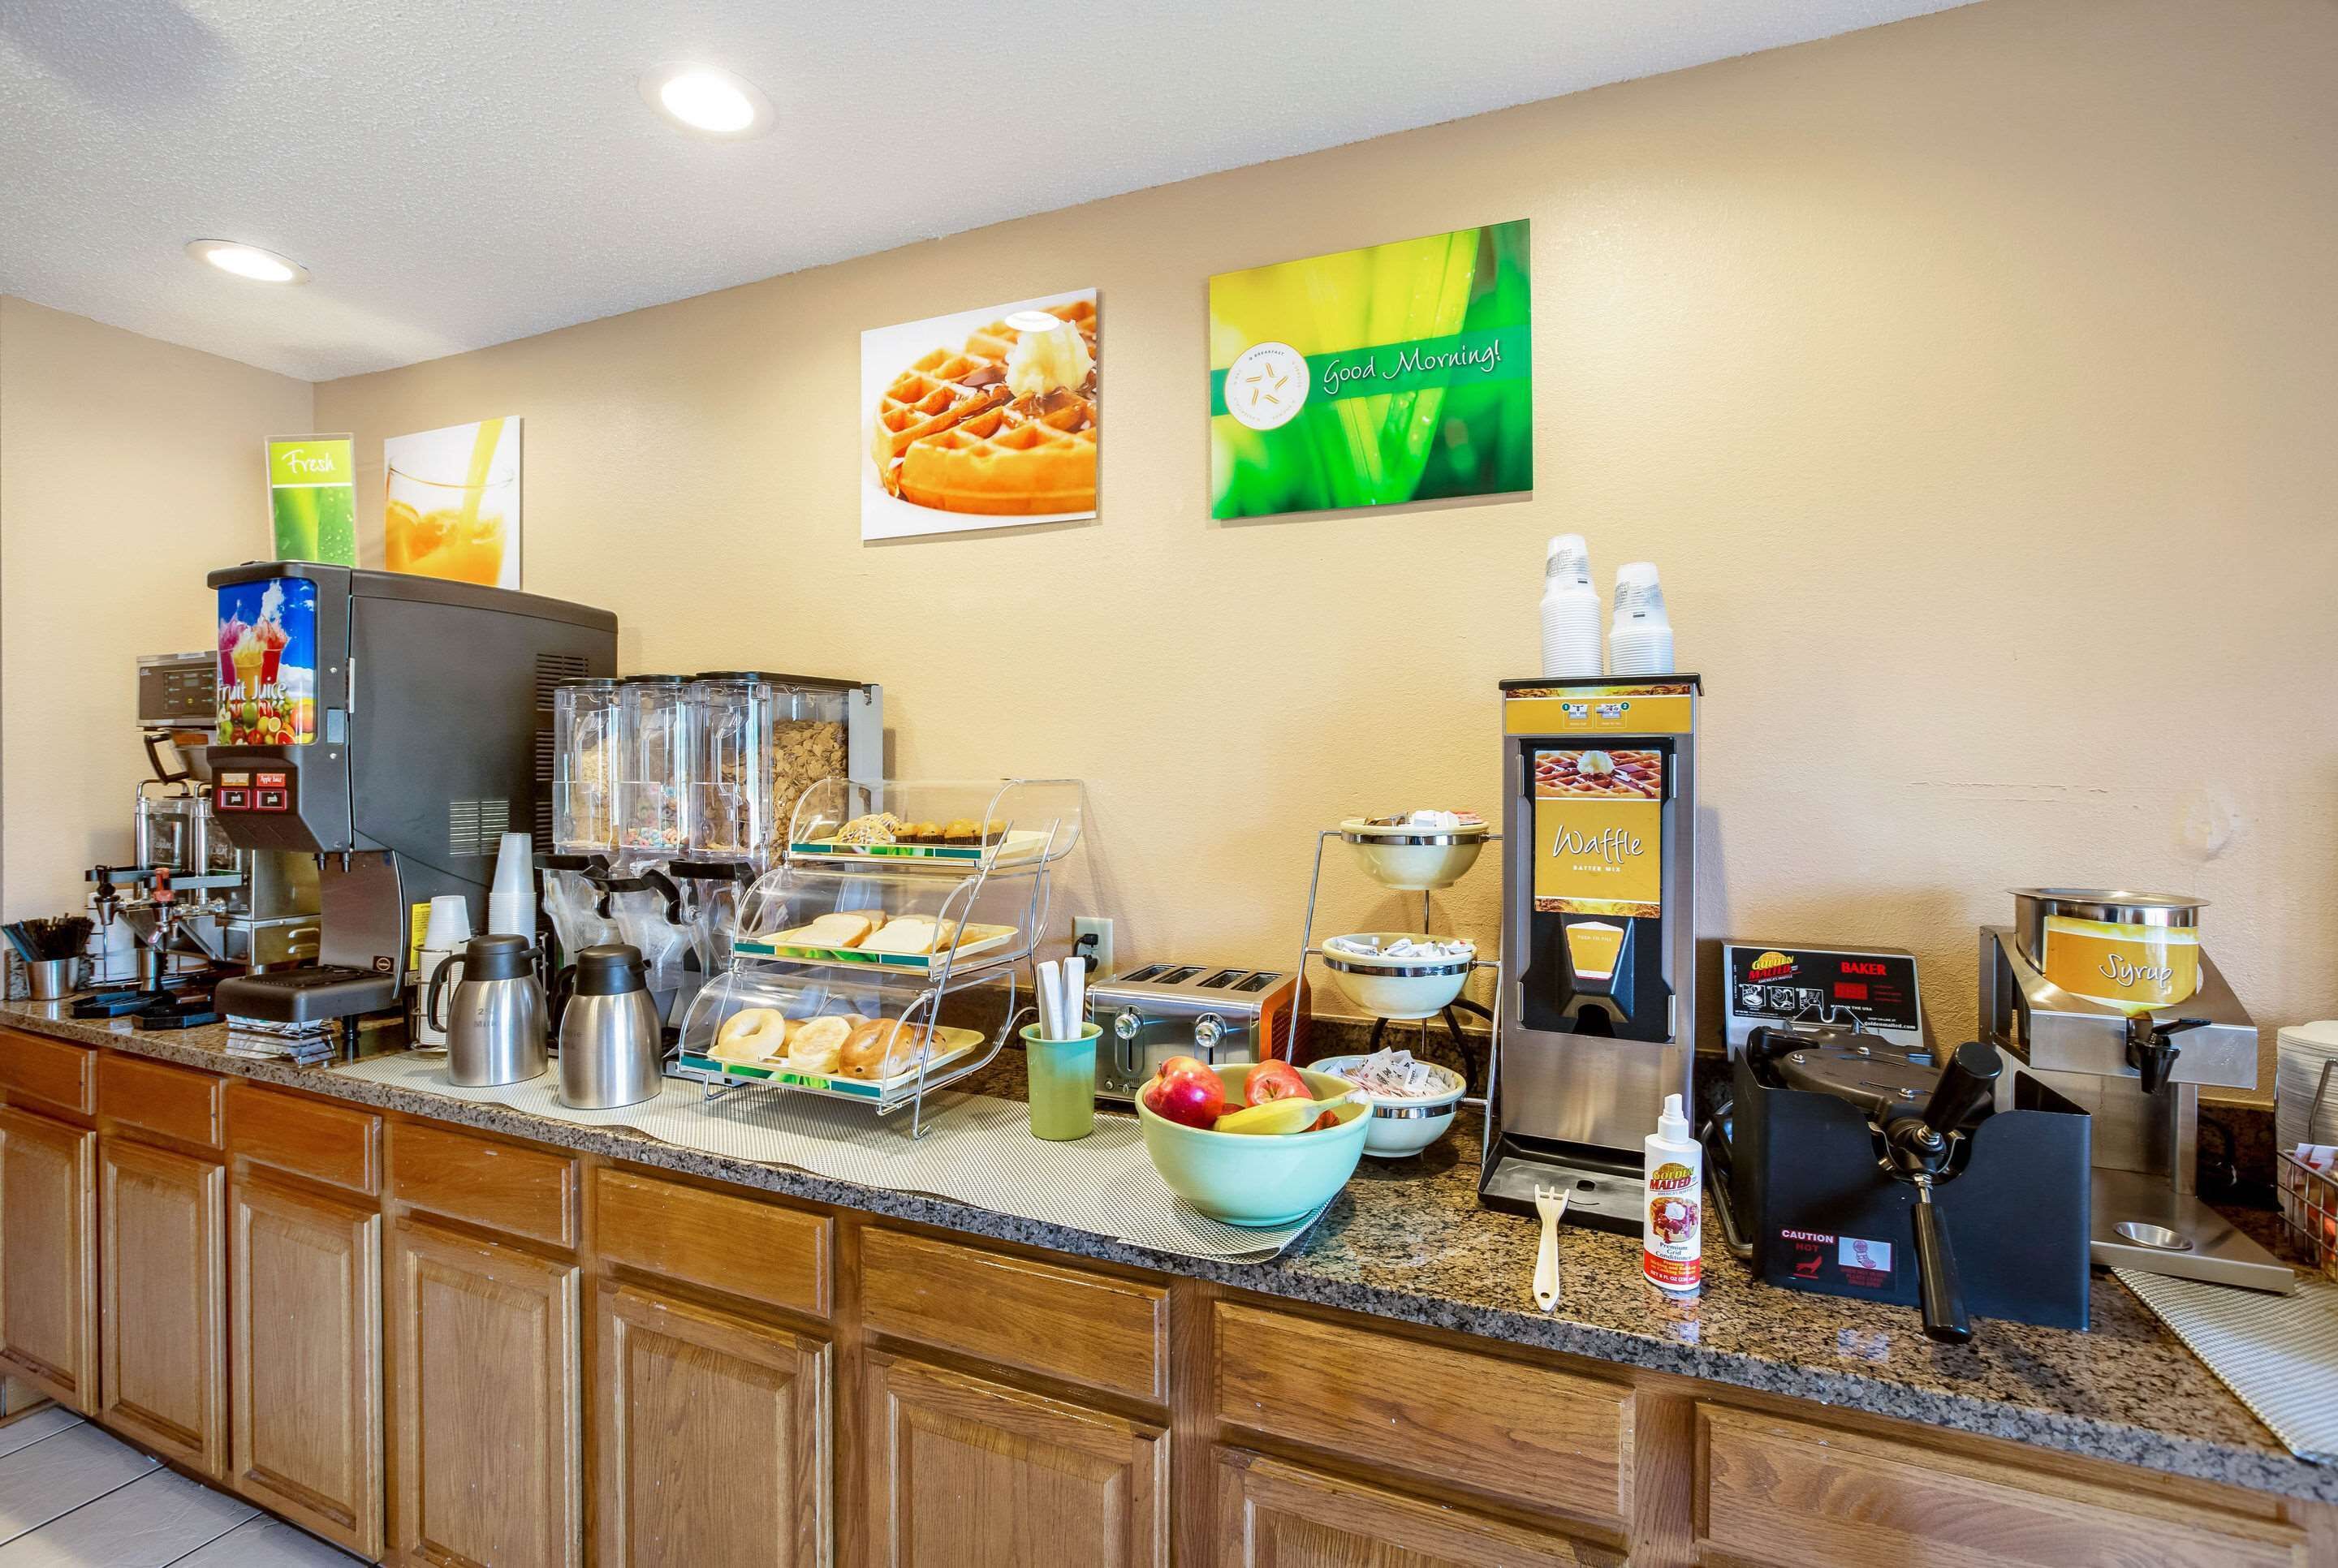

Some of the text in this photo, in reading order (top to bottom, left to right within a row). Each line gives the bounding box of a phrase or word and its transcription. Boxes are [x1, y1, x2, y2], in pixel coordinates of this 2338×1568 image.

[1323, 355, 1376, 395] Good
[1383, 339, 1502, 381] Morning!
[281, 449, 337, 474] Fresh
[252, 674, 287, 700] Juice
[1552, 825, 1644, 864] Waffle
[1751, 955, 1794, 971] GOLDEN
[1840, 961, 1887, 976] BAKER
[1748, 963, 1791, 980] MALTED
[2099, 954, 2173, 989] Syrup
[1653, 1168, 1694, 1180] GOLDEN
[1650, 1176, 1692, 1191] MALTED
[1781, 1230, 1835, 1244] CAUTION
[1659, 1242, 1689, 1251] Premium
[1795, 1243, 1819, 1252] HOT
[1655, 1251, 1693, 1260] Conditioner
